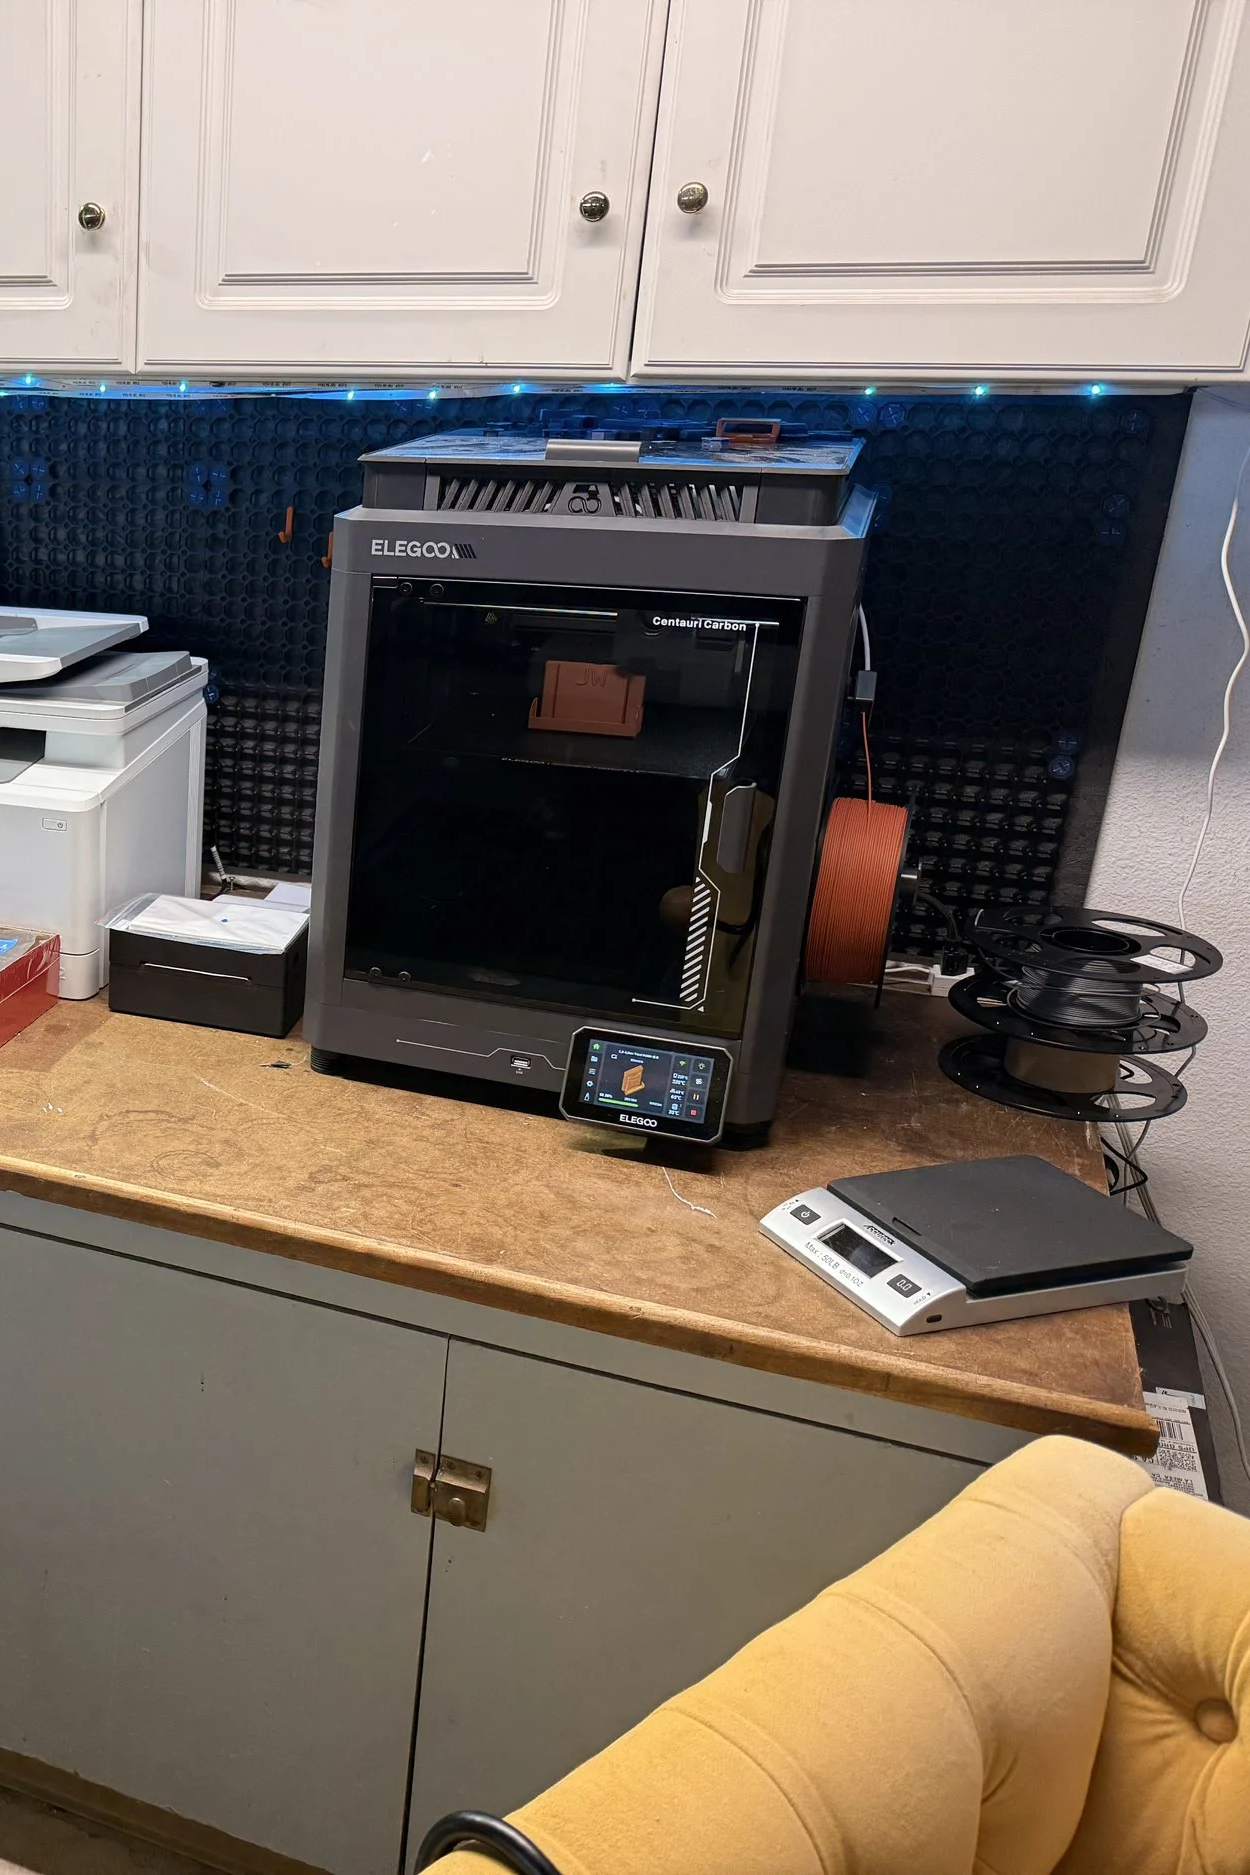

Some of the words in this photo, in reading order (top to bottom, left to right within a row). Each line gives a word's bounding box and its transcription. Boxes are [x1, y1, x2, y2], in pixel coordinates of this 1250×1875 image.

[370, 539, 452, 559] ELEGOO
[652, 616, 702, 629] Centauri
[703, 620, 747, 632] Carbon
[619, 1113, 658, 1128] ELEGOO
[820, 1253, 841, 1270] 50LB
[896, 1279, 912, 1292] 0.0
